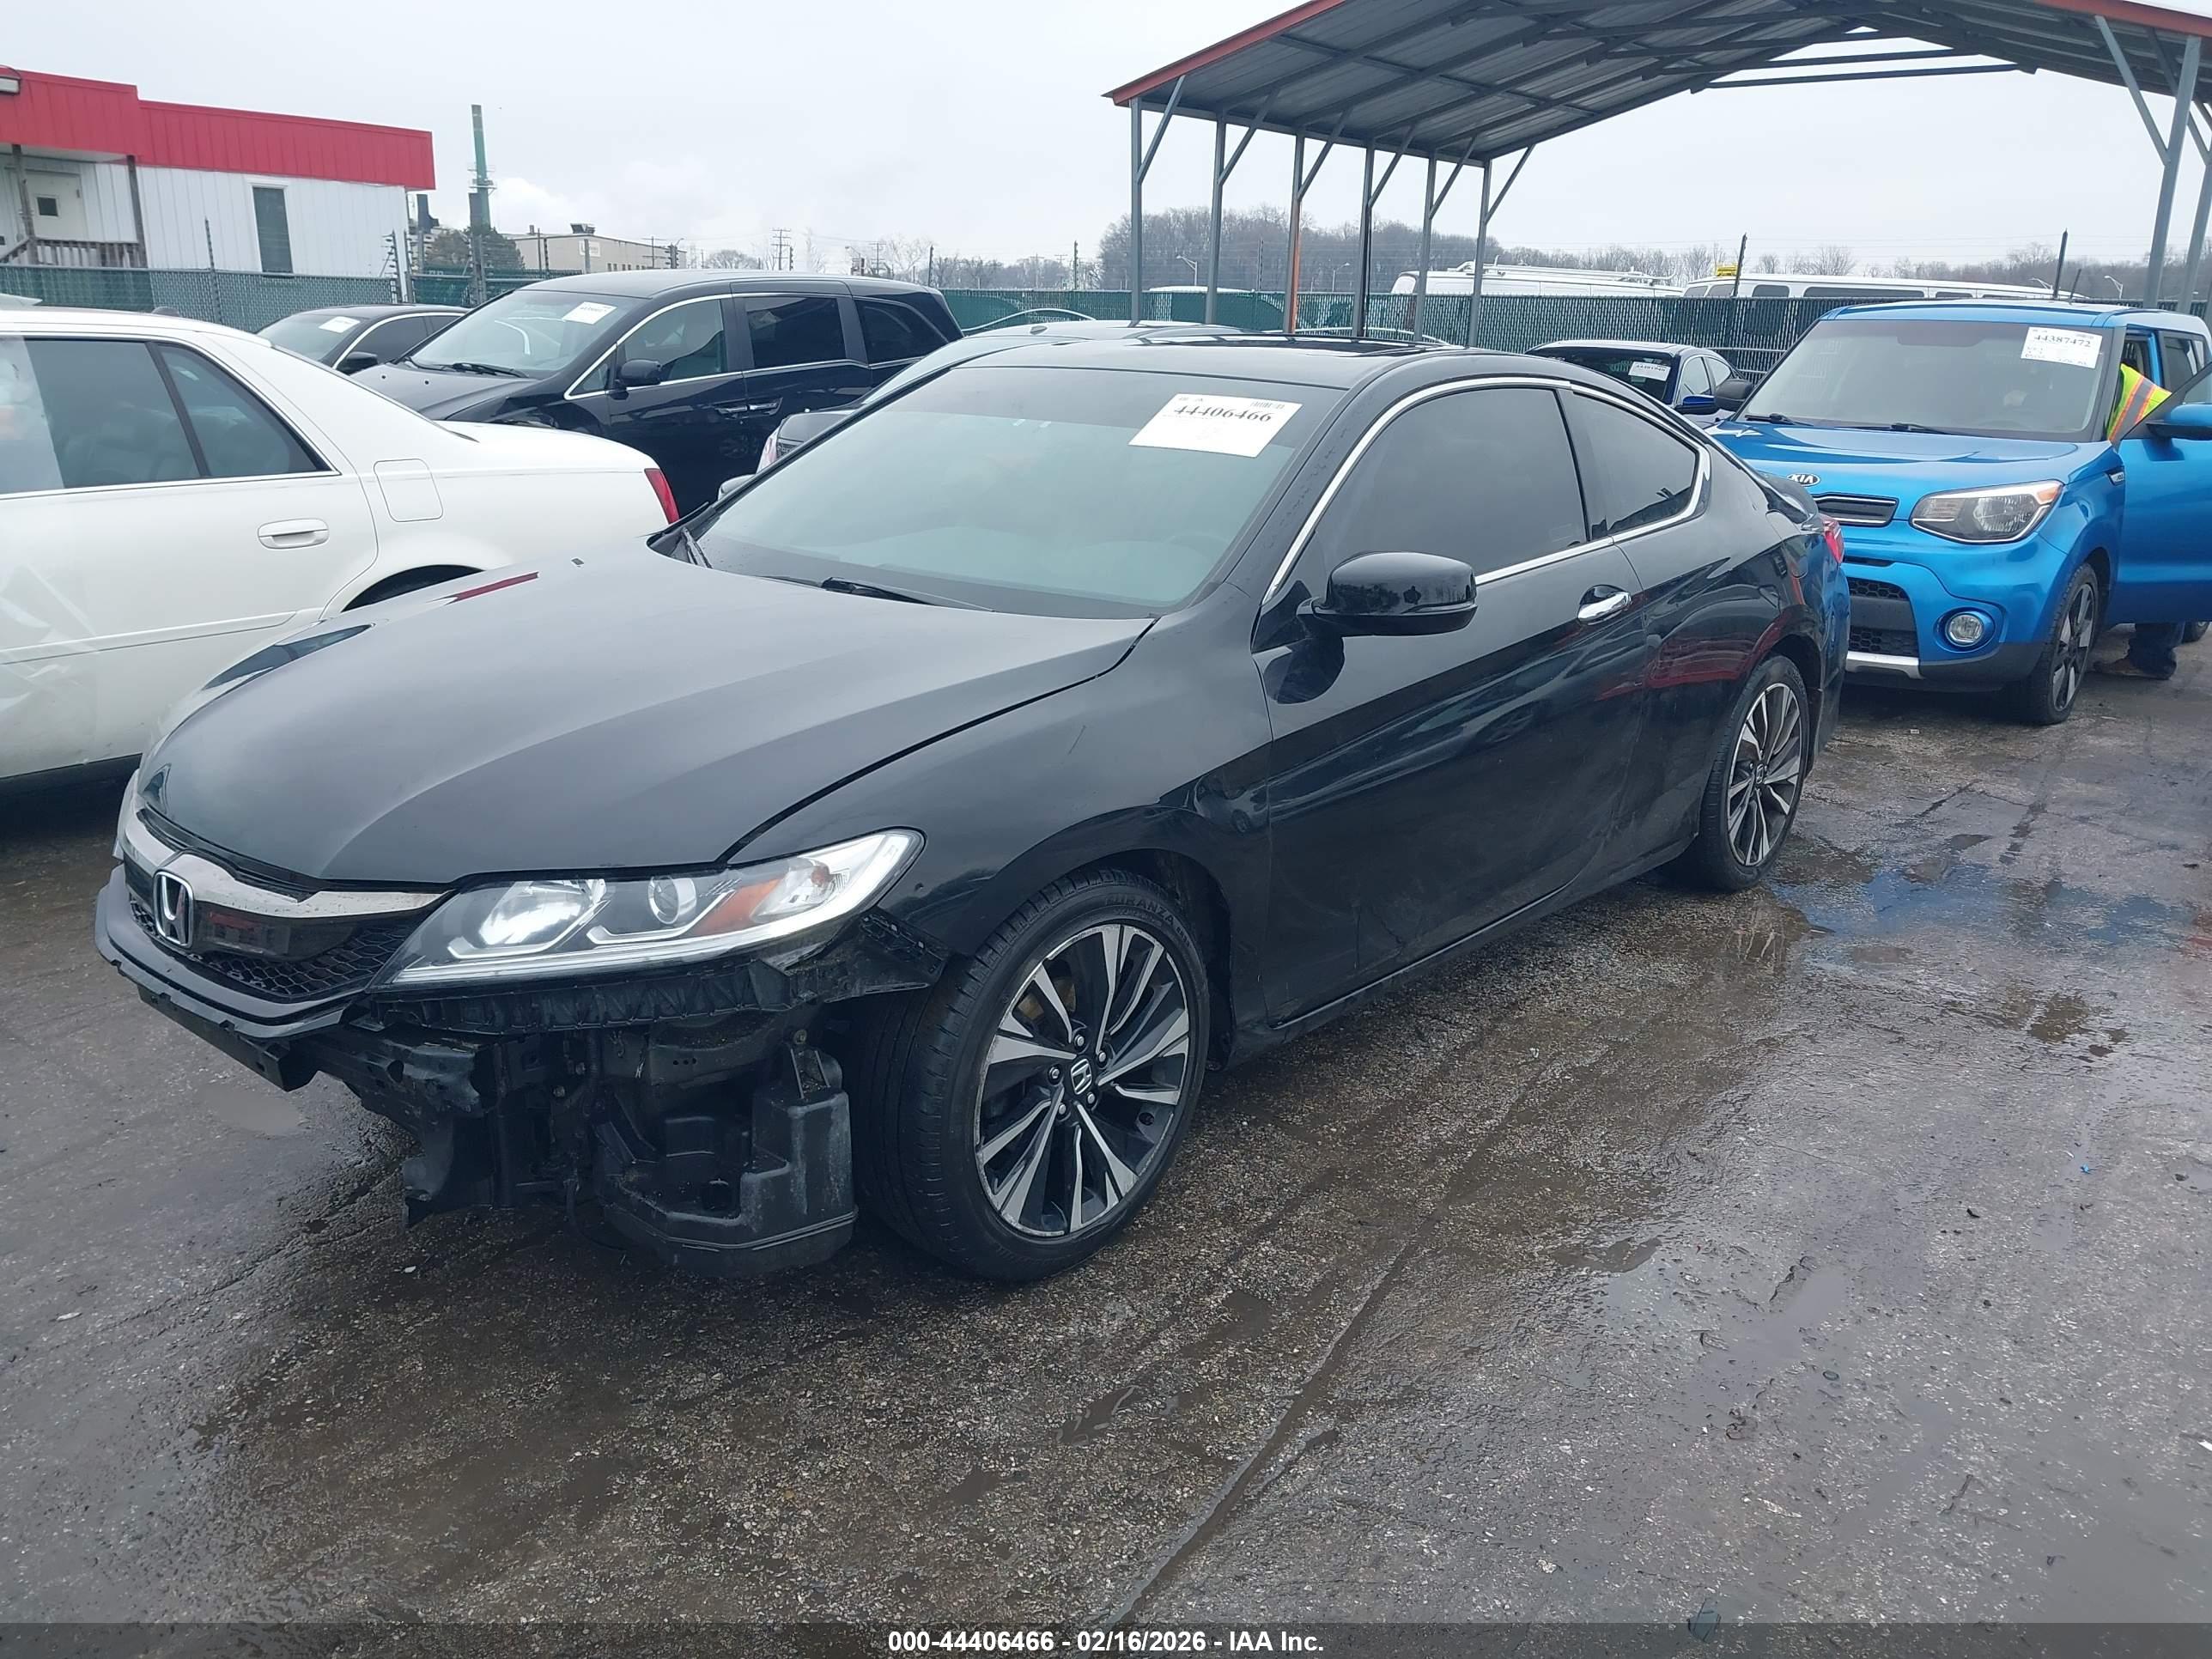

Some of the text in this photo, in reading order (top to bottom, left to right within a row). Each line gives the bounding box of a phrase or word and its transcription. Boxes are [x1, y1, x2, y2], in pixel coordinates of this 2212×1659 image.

[2033, 334, 2091, 348] 44387472
[1173, 404, 1273, 422] 44406466
[1790, 474, 1814, 483] KIA
